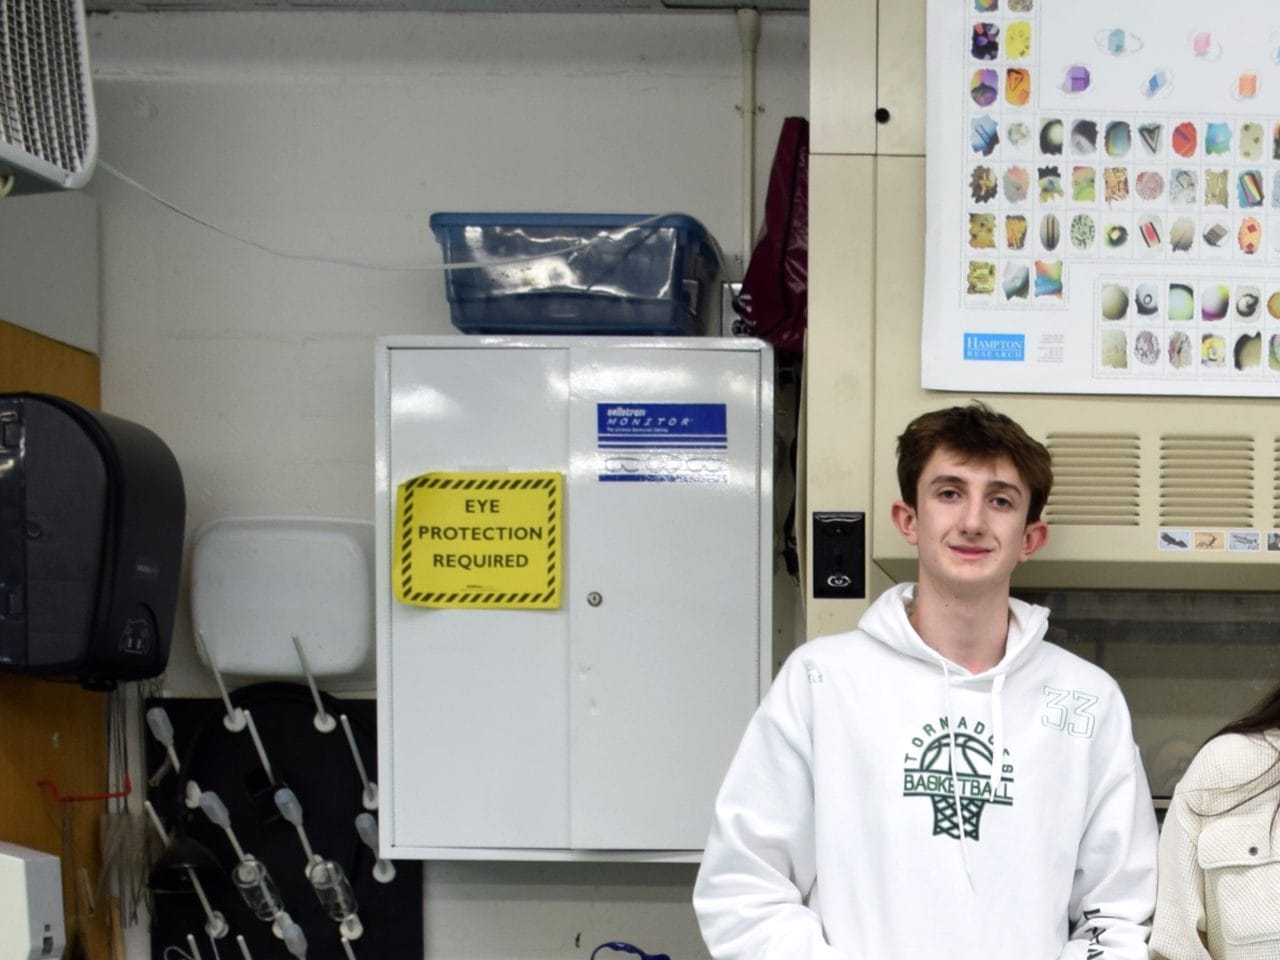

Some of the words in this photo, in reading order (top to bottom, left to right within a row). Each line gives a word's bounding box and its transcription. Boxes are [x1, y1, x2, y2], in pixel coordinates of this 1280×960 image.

[967, 336, 1022, 350] HAMPTON
[465, 499, 500, 513] EYE
[418, 525, 543, 541] PROTECTION
[432, 553, 529, 571] REQUIRED
[1041, 685, 1099, 739] 33
